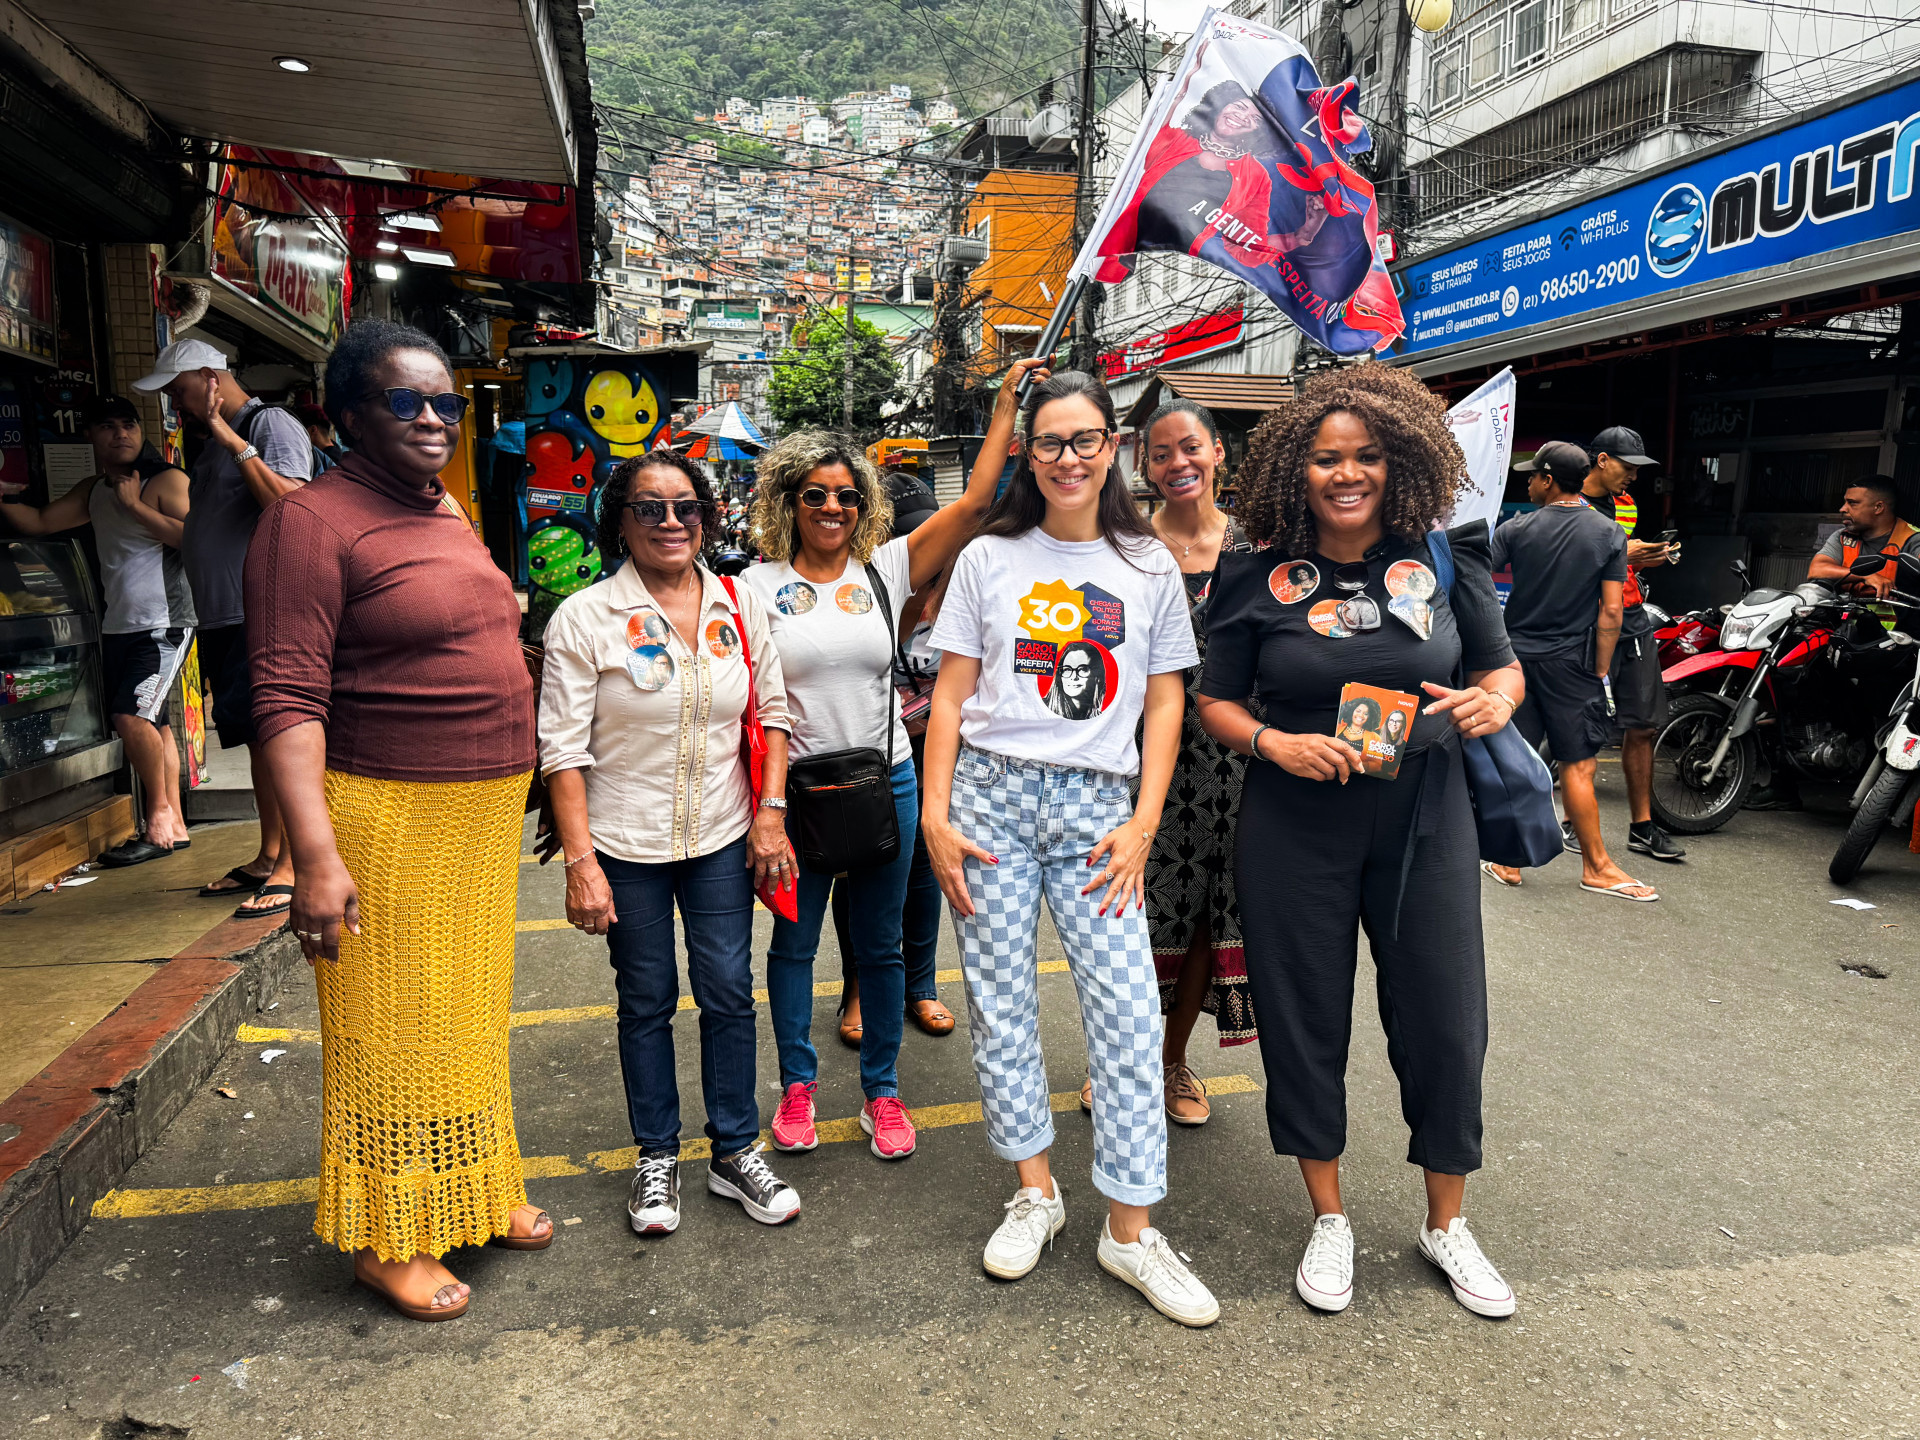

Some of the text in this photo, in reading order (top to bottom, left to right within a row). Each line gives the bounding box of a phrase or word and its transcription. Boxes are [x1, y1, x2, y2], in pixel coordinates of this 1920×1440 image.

[1188, 199, 1263, 253] A GENTE
[1580, 219, 1629, 245] WI-FI PLUS
[1581, 209, 1617, 232] GRÁTIS
[1502, 234, 1552, 260] FEITA PARA
[1431, 258, 1479, 283] SEUS VÍDEOS
[1502, 247, 1551, 272] SEUS JOGOS
[264, 233, 310, 317] Max
[1430, 273, 1472, 294] SEM TRAVAR
[1522, 254, 1640, 310] (21) 98650-2900
[1422, 290, 1500, 321] WWW.MULTNET.RIO.BR
[1454, 311, 1500, 333] @MULTNETRIO
[53, 409, 76, 433] 11
[1490, 407, 1503, 451] CIDADE
[531, 492, 562, 501] EDUARDO
[564, 495, 584, 509] 55
[1026, 598, 1081, 632] 30
[1089, 600, 1112, 608] CHEGA
[1016, 641, 1055, 654] CAROL
[1016, 651, 1054, 661] SPONZA
[1016, 659, 1053, 668] PREFEITA
[1397, 700, 1414, 708] NOVO
[1368, 746, 1395, 757] SPONZA
[1369, 740, 1396, 752] CAROL
[1383, 755, 1395, 763] 30
